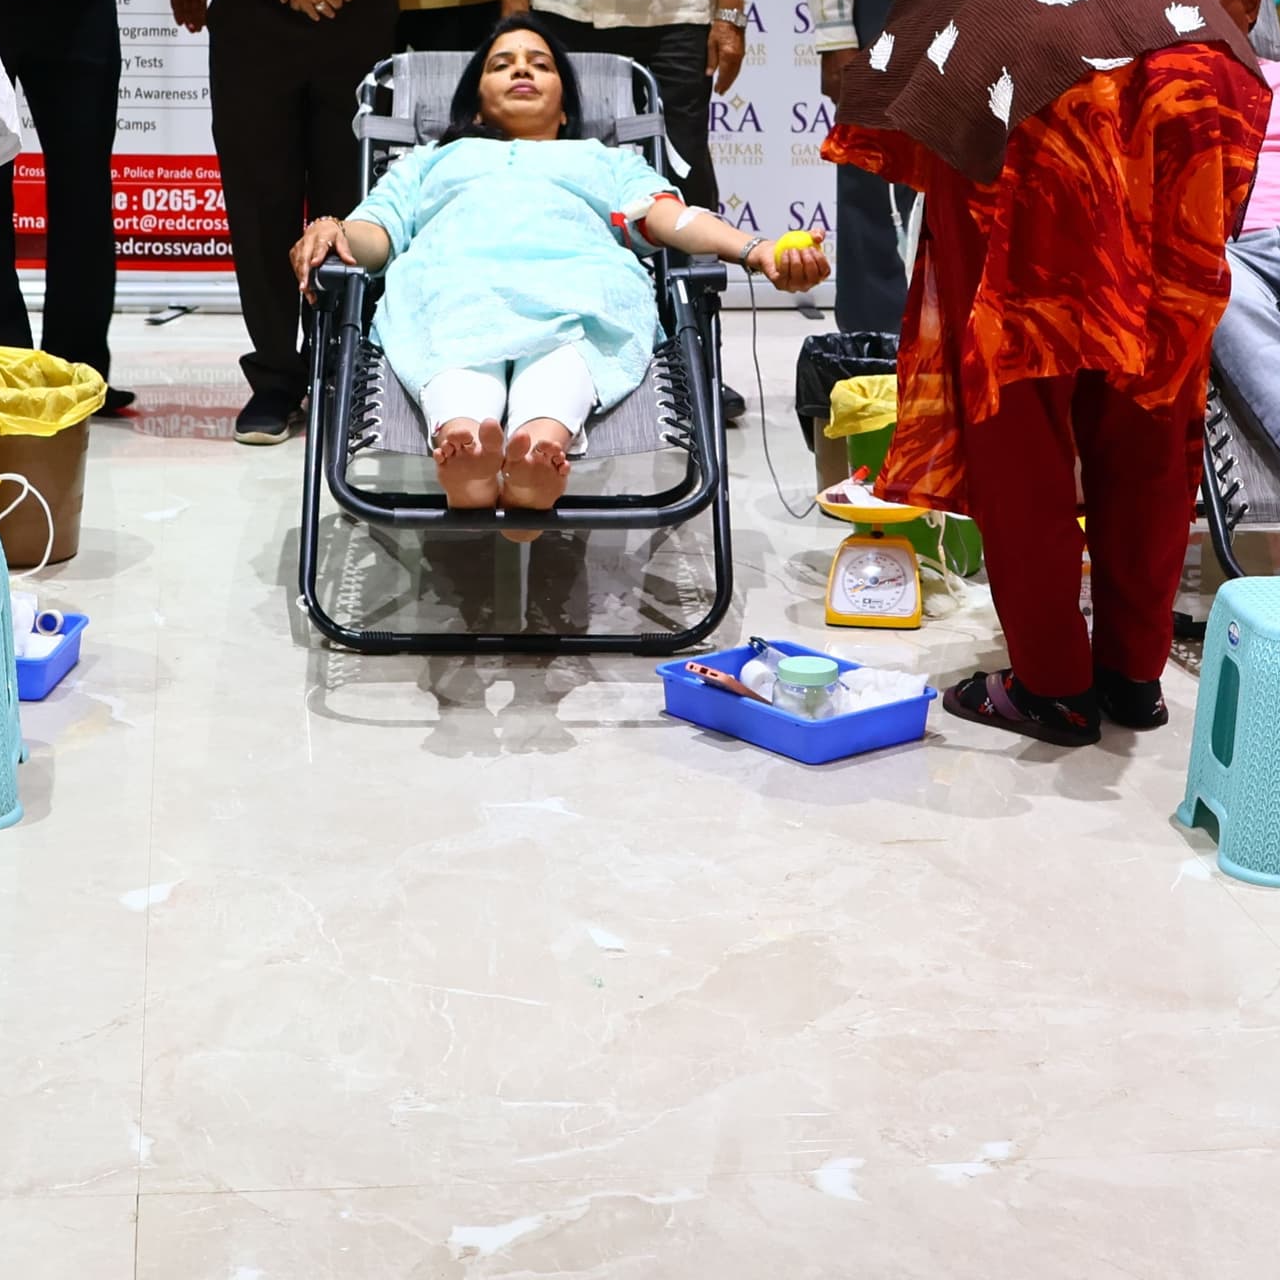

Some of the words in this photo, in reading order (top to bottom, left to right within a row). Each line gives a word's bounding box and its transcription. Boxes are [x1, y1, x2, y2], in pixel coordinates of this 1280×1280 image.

[120, 26, 178, 39] rogramme
[134, 56, 164, 68] Tests
[134, 87, 198, 100] Awareness
[117, 118, 157, 133] Camps
[19, 164, 45, 177] Cross
[123, 167, 155, 179] Police
[157, 167, 193, 179] Parade
